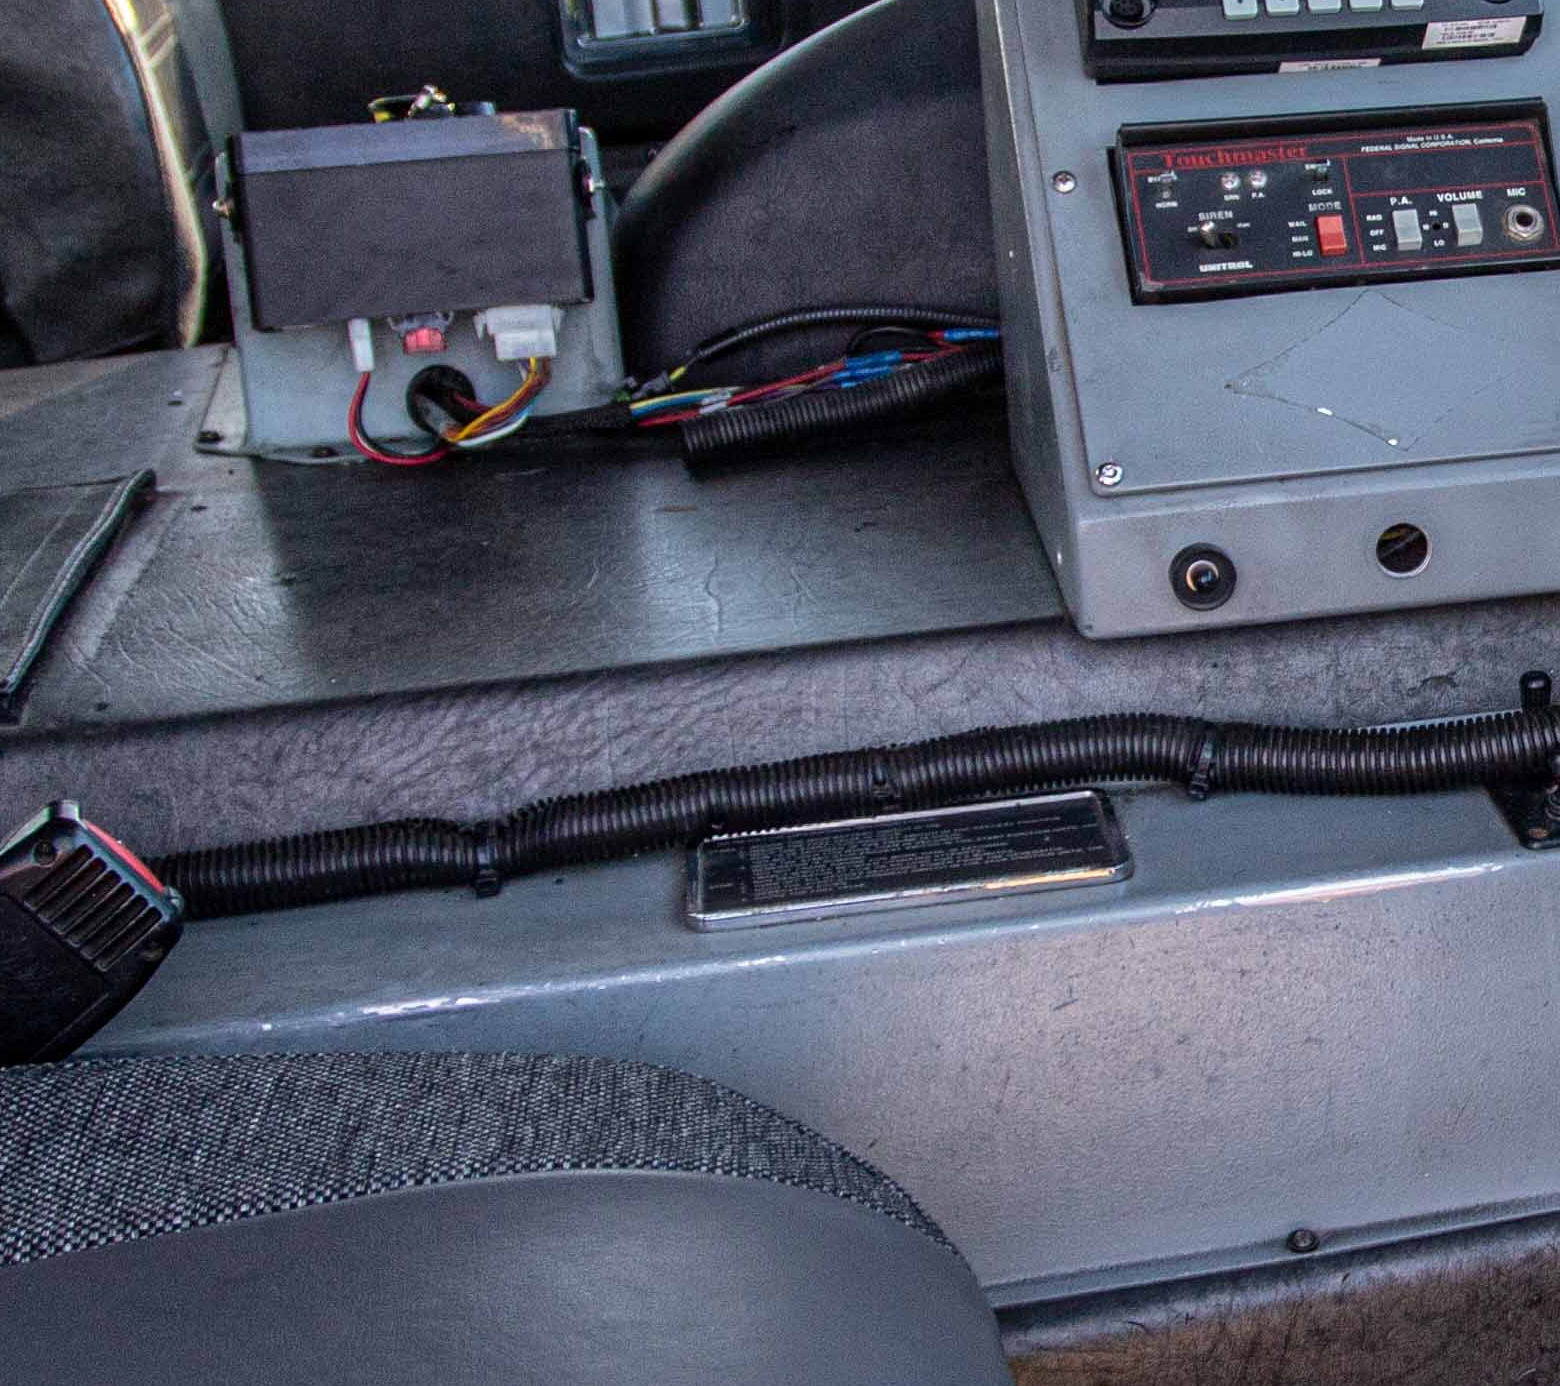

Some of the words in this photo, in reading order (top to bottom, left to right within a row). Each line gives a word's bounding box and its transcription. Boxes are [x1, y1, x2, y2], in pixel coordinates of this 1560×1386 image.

[1361, 145, 1392, 154] FEDERAL
[1394, 142, 1419, 152] SIGNAL
[1163, 145, 1307, 168] Touchmaster
[1312, 187, 1333, 197] LOCK
[1436, 190, 1484, 203] VOLUME
[1506, 186, 1527, 197] MIC
[1308, 201, 1343, 212] MODE
[1390, 196, 1413, 206] P.A.
[1198, 209, 1234, 222] SIREN
[1370, 228, 1385, 237] OFF
[1199, 260, 1254, 273] UNITROL
